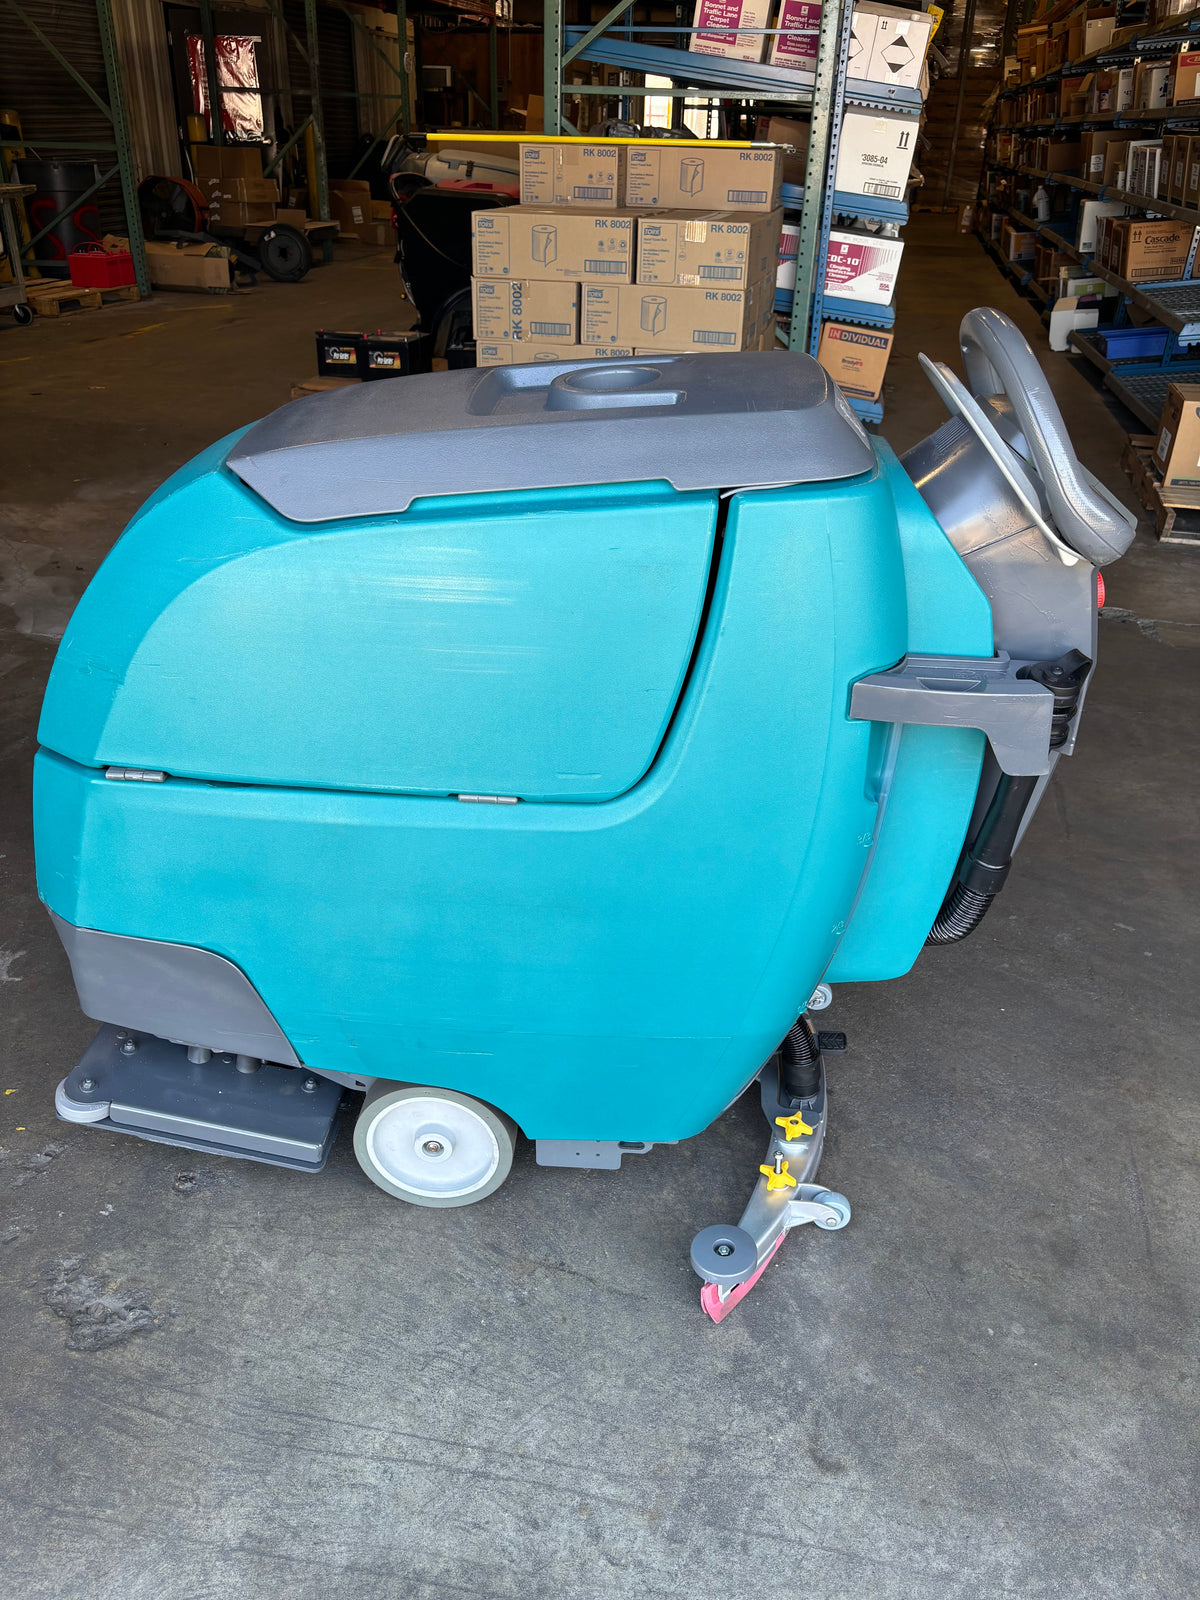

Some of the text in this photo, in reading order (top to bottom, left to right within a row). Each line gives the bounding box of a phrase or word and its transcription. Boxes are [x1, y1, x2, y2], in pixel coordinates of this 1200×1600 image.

[705, 1, 726, 10] Bonnet
[709, 15, 730, 23] Carpet
[786, 14, 808, 22] Bonnet
[784, 21, 803, 29] Traffic
[787, 34, 811, 43] Cleaner
[583, 149, 616, 157] RK 8002
[739, 152, 773, 161] RK 8002
[595, 219, 631, 229] RK 8002
[711, 224, 748, 234] RK 8002
[1145, 233, 1180, 245] Cascade
[705, 292, 742, 302] RK 8002
[512, 282, 522, 340] RK 8002
[829, 328, 887, 348] INDIVIDUAL
[595, 348, 630, 357] RK 8002
